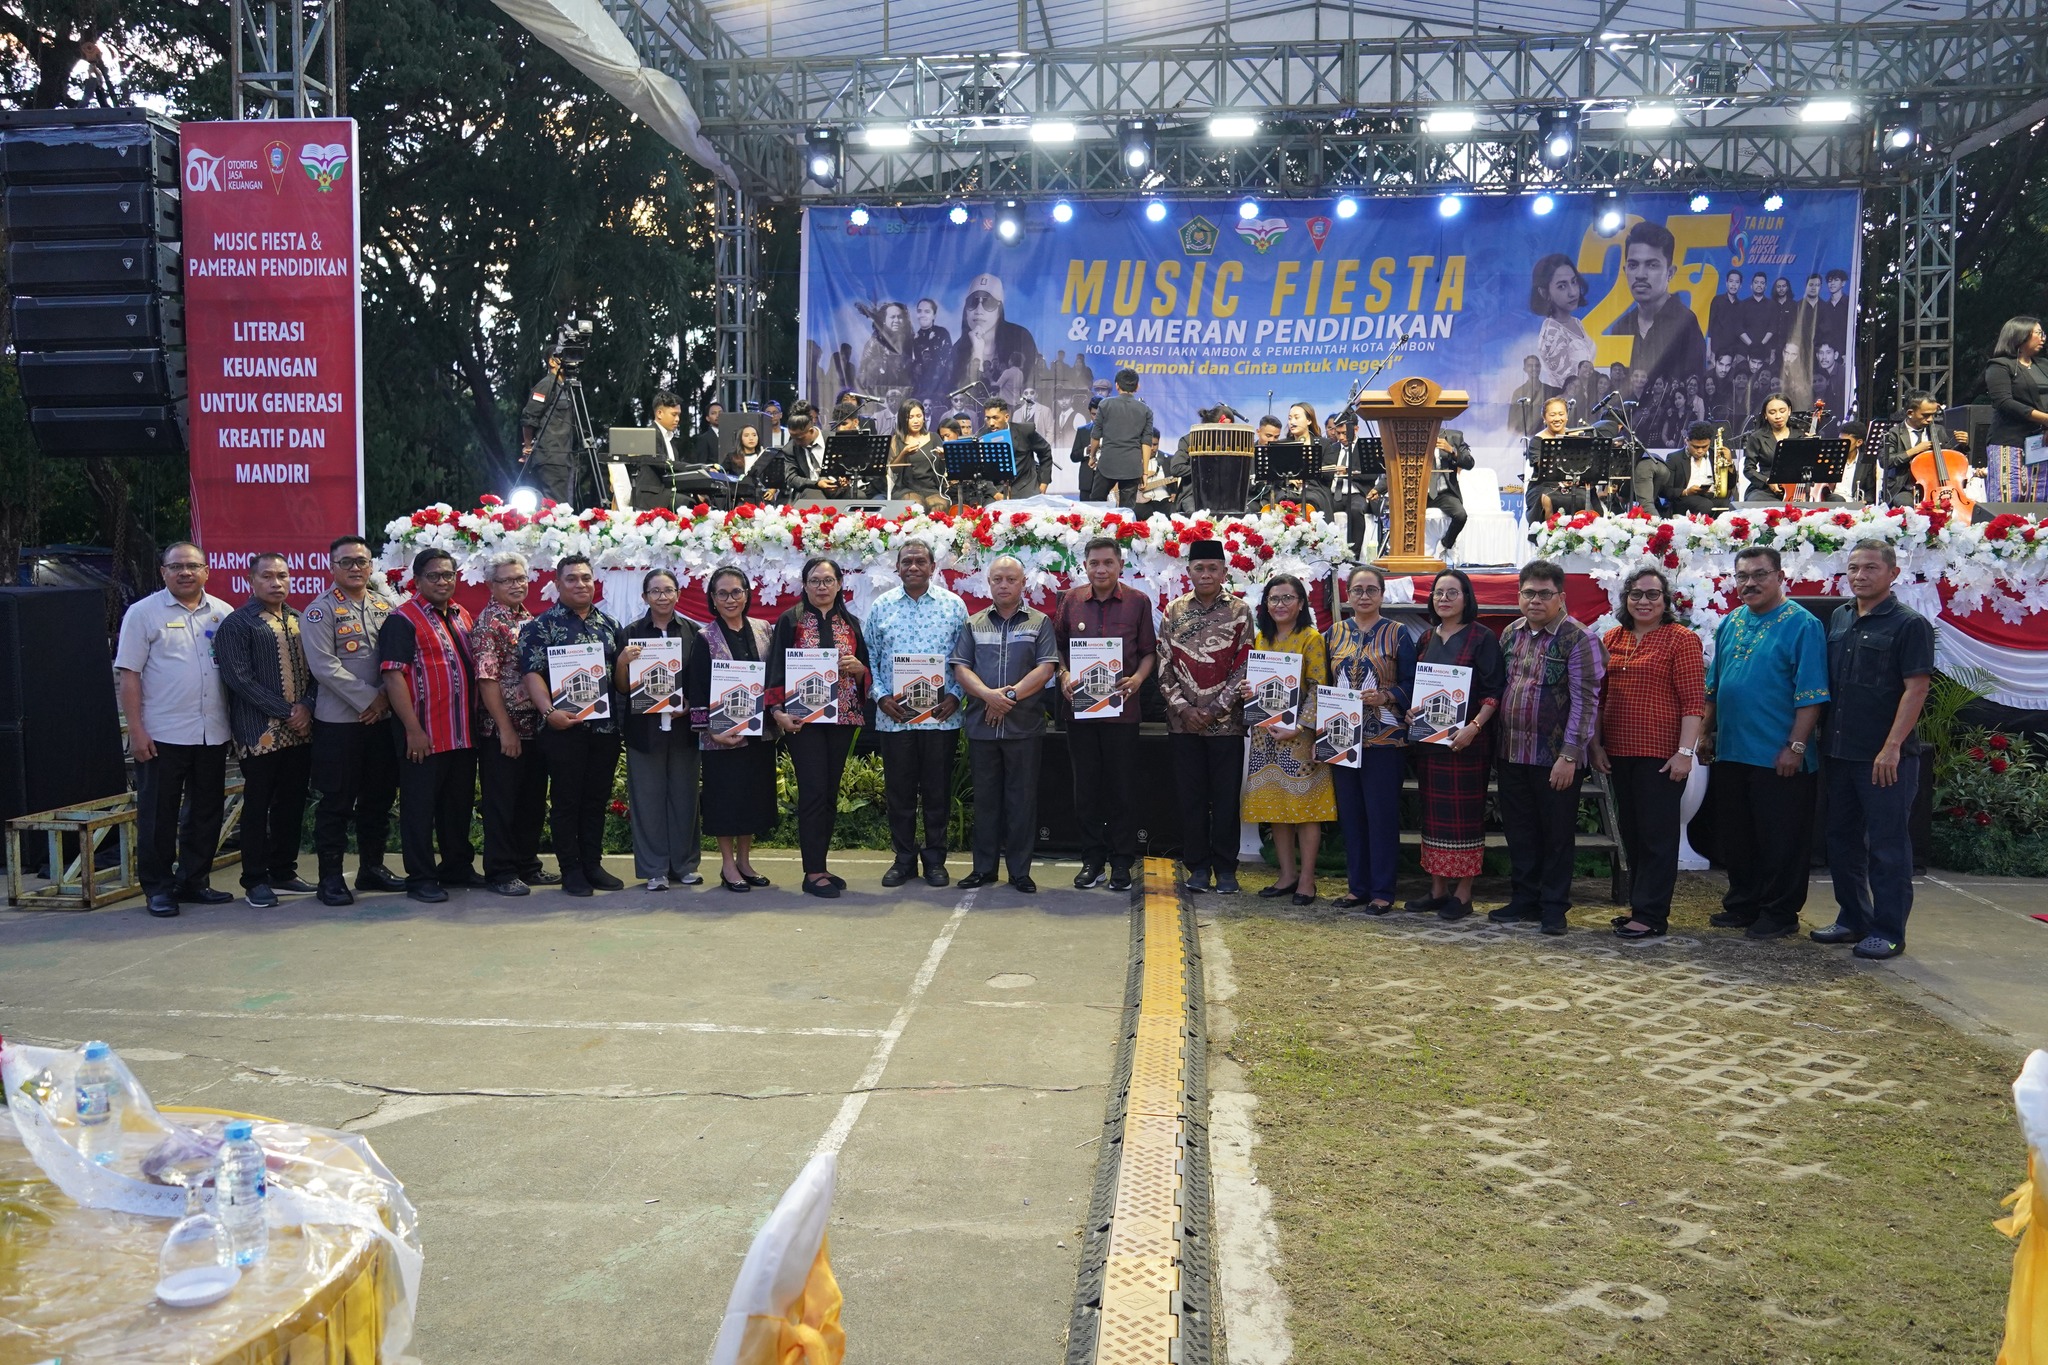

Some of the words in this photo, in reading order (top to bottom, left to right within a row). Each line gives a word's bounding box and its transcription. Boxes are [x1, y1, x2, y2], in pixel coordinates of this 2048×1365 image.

[186, 149, 225, 192] OJK
[227, 160, 258, 170] OTORITAS
[228, 171, 243, 180] JASA
[228, 181, 263, 190] KEUANGAN
[1745, 216, 1785, 230] TAHUN
[213, 232, 257, 251] MUSIC
[261, 232, 307, 251] FIESTA
[311, 231, 322, 251] &
[1751, 235, 1780, 245] PRODI
[1749, 244, 1779, 255] MUSIK
[1747, 254, 1758, 264] DI
[1758, 254, 1797, 264] MALUKU
[189, 258, 256, 277] PAMERAN
[261, 258, 347, 277] PENDIDIKAN
[1060, 259, 1244, 318] MUSIC
[1270, 255, 1467, 317] FIESTA
[234, 321, 305, 342] LITERASI
[1067, 316, 1092, 342] &
[1097, 318, 1248, 345] PAMERAN
[1255, 314, 1454, 345] PENDIDIKAN
[1086, 344, 1164, 357] KOLABORASI
[1168, 346, 1198, 357] IAKN
[1202, 347, 1248, 357] AMBON
[1252, 347, 1262, 357] &
[1266, 344, 1348, 357] PEMERINTAH
[1352, 343, 1385, 354] KOTA
[1389, 341, 1436, 352] AMBON
[223, 357, 317, 378] KEUANGAN
[1198, 360, 1229, 375] dan
[1233, 360, 1278, 375] Cinta
[1281, 359, 1332, 374] untuk
[200, 393, 259, 413] UNTUK
[262, 393, 343, 413] GENERASI
[219, 428, 285, 449] KREATIF
[289, 428, 325, 449] DAN
[236, 463, 310, 484] MANDIRI
[1249, 652, 1266, 660] IAKN
[1417, 665, 1433, 673] IAKN
[1318, 688, 1332, 696] IAKN
